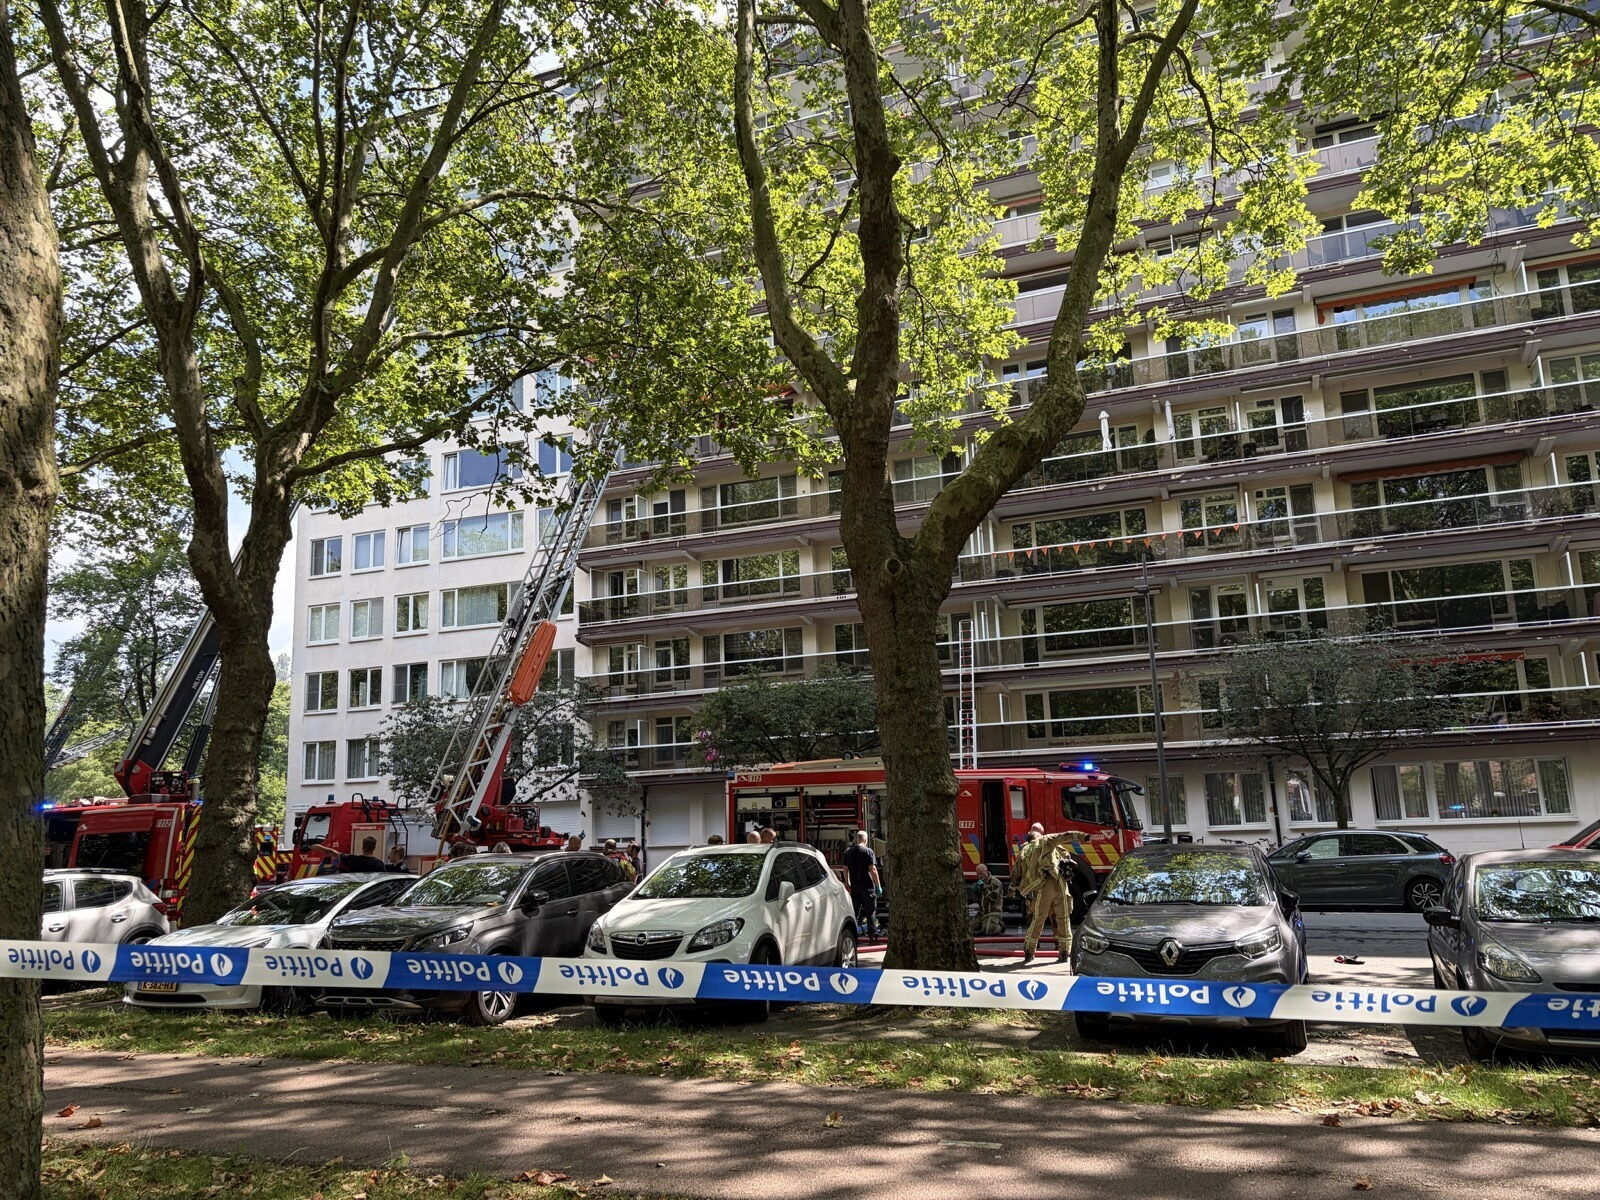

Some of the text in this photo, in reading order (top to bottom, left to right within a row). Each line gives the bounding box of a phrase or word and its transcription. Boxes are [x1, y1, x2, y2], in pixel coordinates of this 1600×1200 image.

[8, 949, 75, 972] Politie
[131, 952, 205, 976] Politie
[265, 955, 343, 978] Politie
[407, 958, 491, 983] Politie
[560, 965, 649, 987] Politie
[724, 970, 821, 992] Politie
[904, 976, 1006, 998] Politie
[1097, 982, 1210, 1005] Politie
[1312, 991, 1437, 1013] Politie
